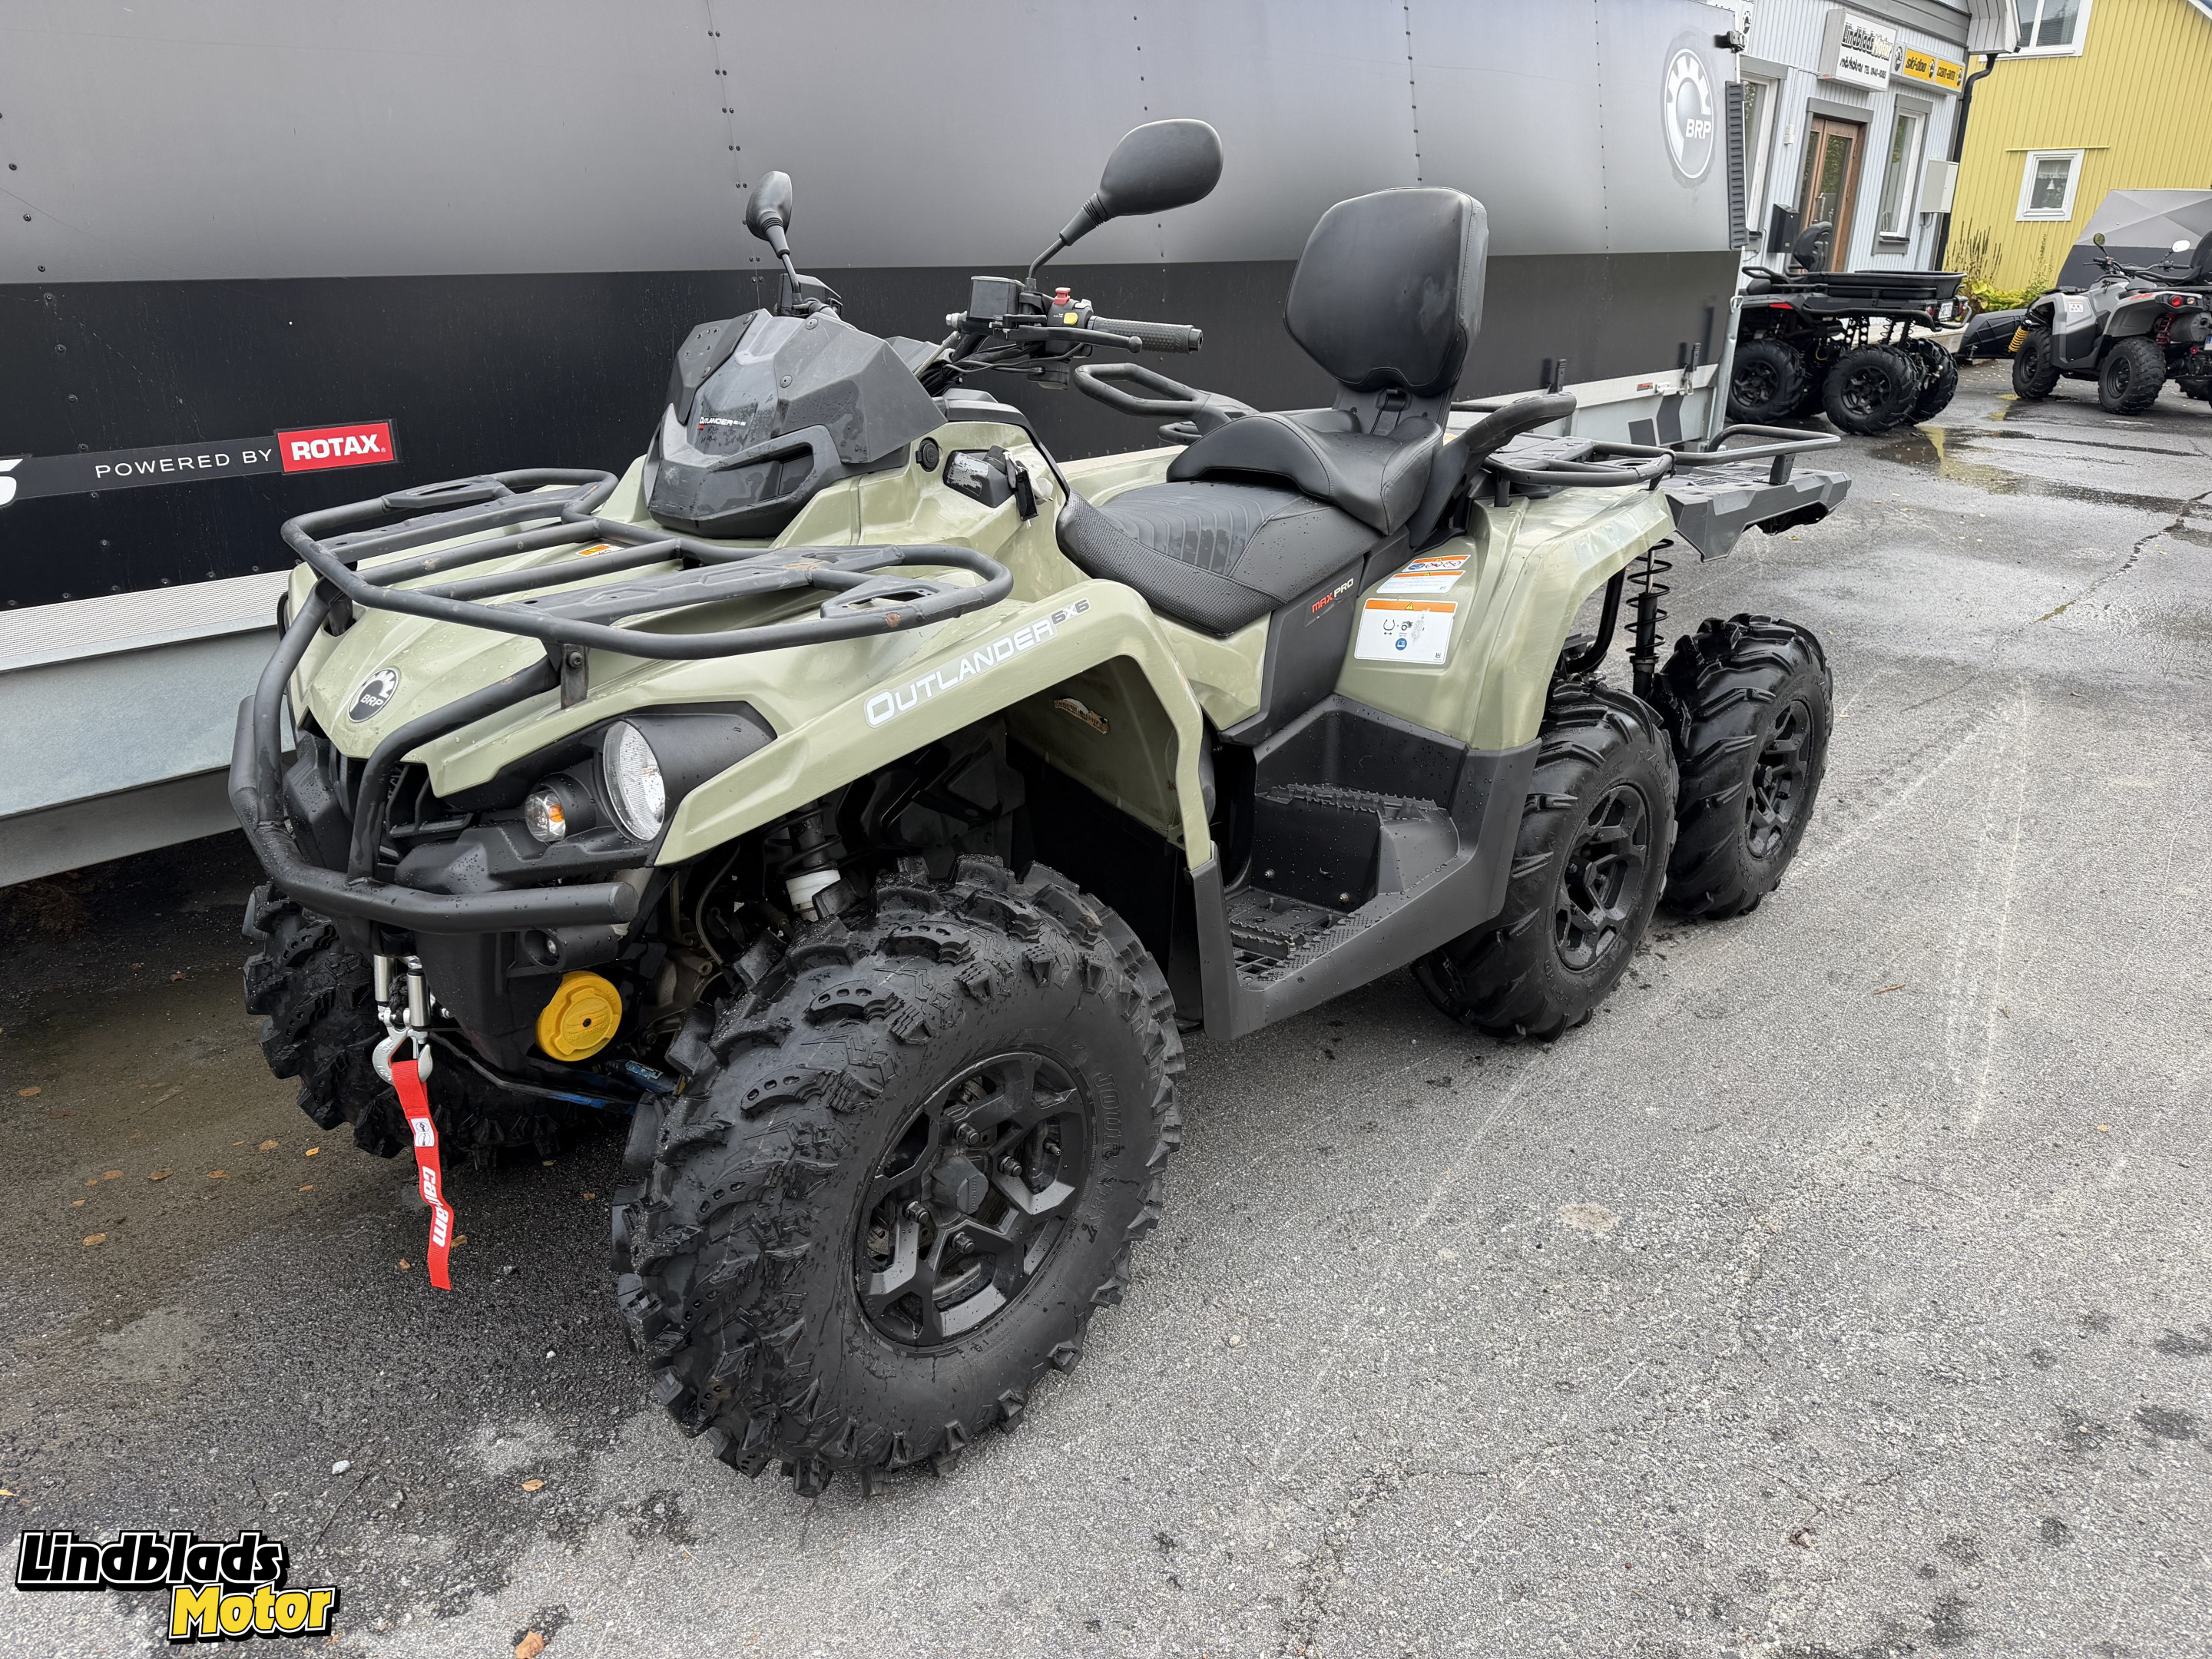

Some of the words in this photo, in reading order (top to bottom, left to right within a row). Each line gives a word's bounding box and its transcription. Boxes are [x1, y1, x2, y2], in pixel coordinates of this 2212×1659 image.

[1906, 56, 1927, 73] ski-doo
[1685, 118, 1712, 140] BRP
[94, 454, 230, 478] POWERED
[241, 449, 272, 464] BY
[1312, 591, 1333, 614] MAX
[1333, 578, 1354, 598] PRO
[866, 618, 1055, 726] OUTLANDER
[359, 694, 384, 707] BRP
[1081, 1071, 1123, 1243] JOURNEY
